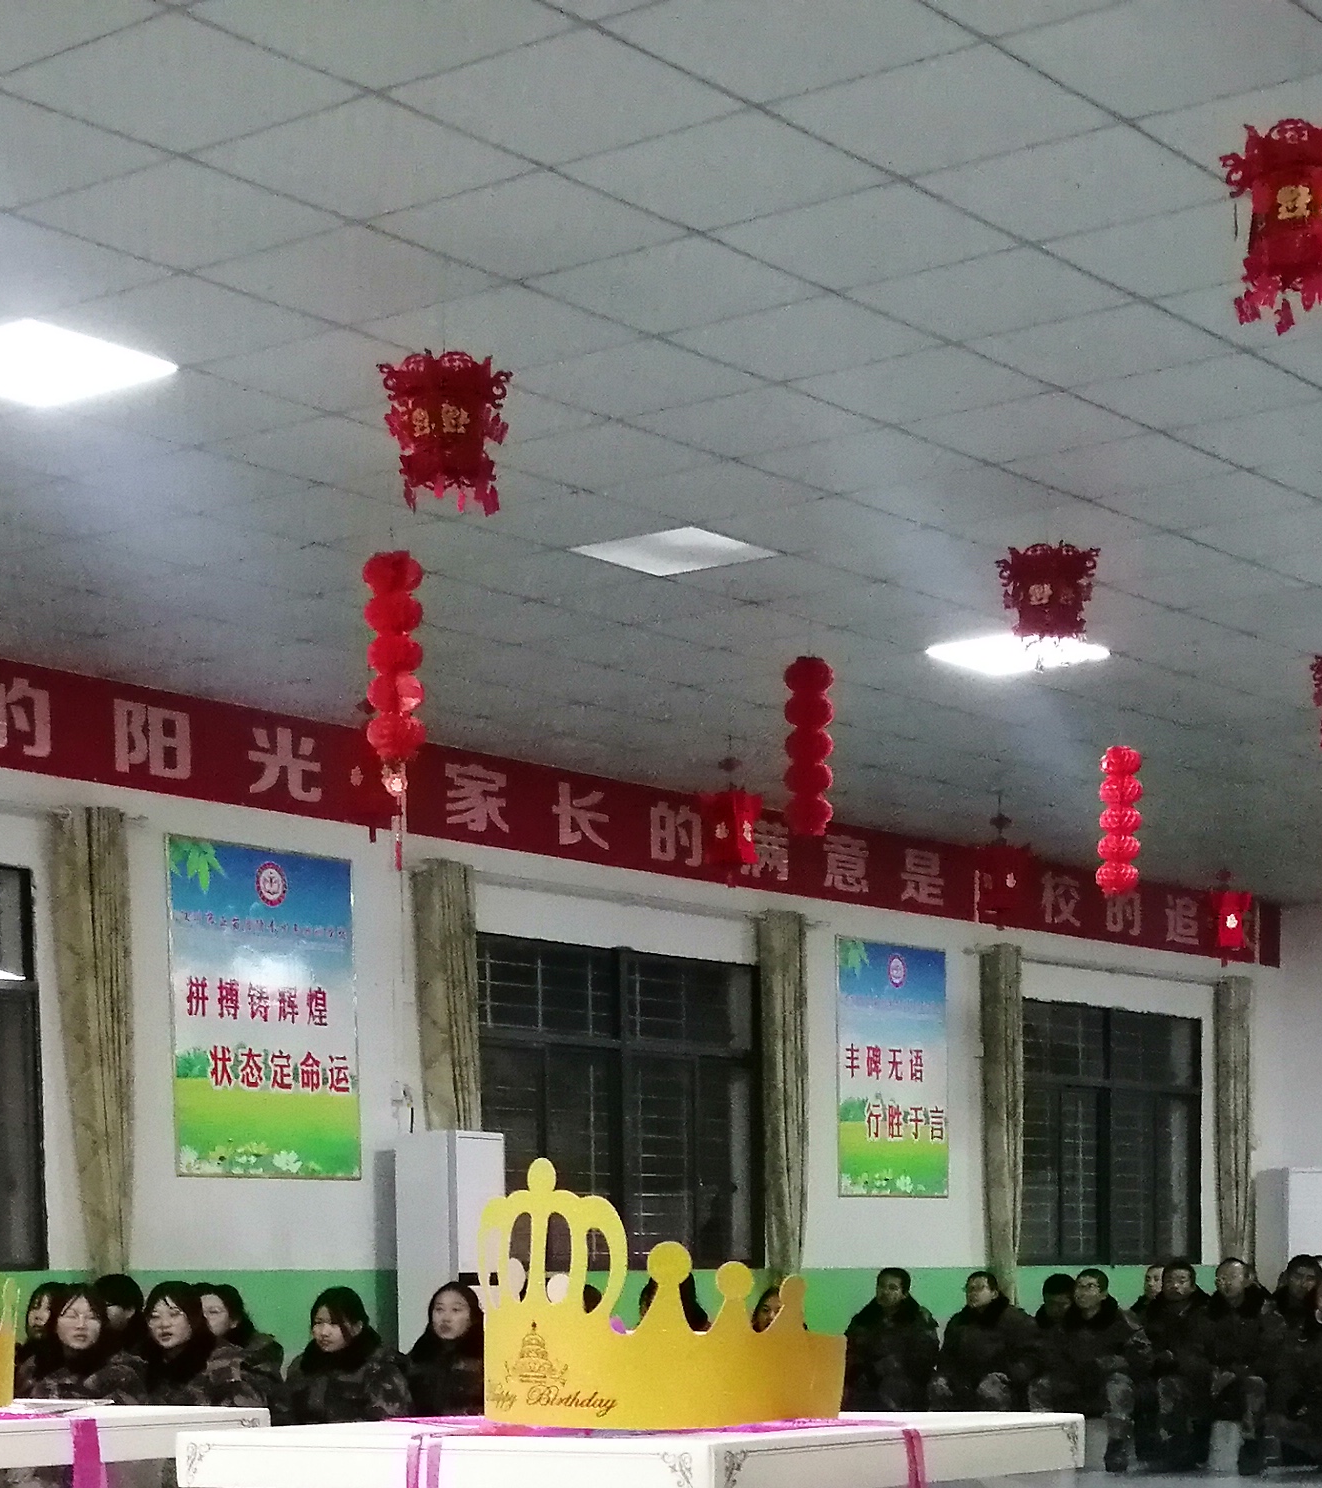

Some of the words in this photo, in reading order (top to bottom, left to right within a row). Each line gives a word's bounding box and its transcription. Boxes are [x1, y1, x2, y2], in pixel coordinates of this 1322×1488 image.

[186, 975, 329, 1027] 拼搏铸辉煌
[209, 1044, 351, 1094] 状态定命运
[844, 1043, 924, 1083] 丰碑无语
[865, 1105, 945, 1141] 行胜于言
[526, 1384, 618, 1418] Birthday
